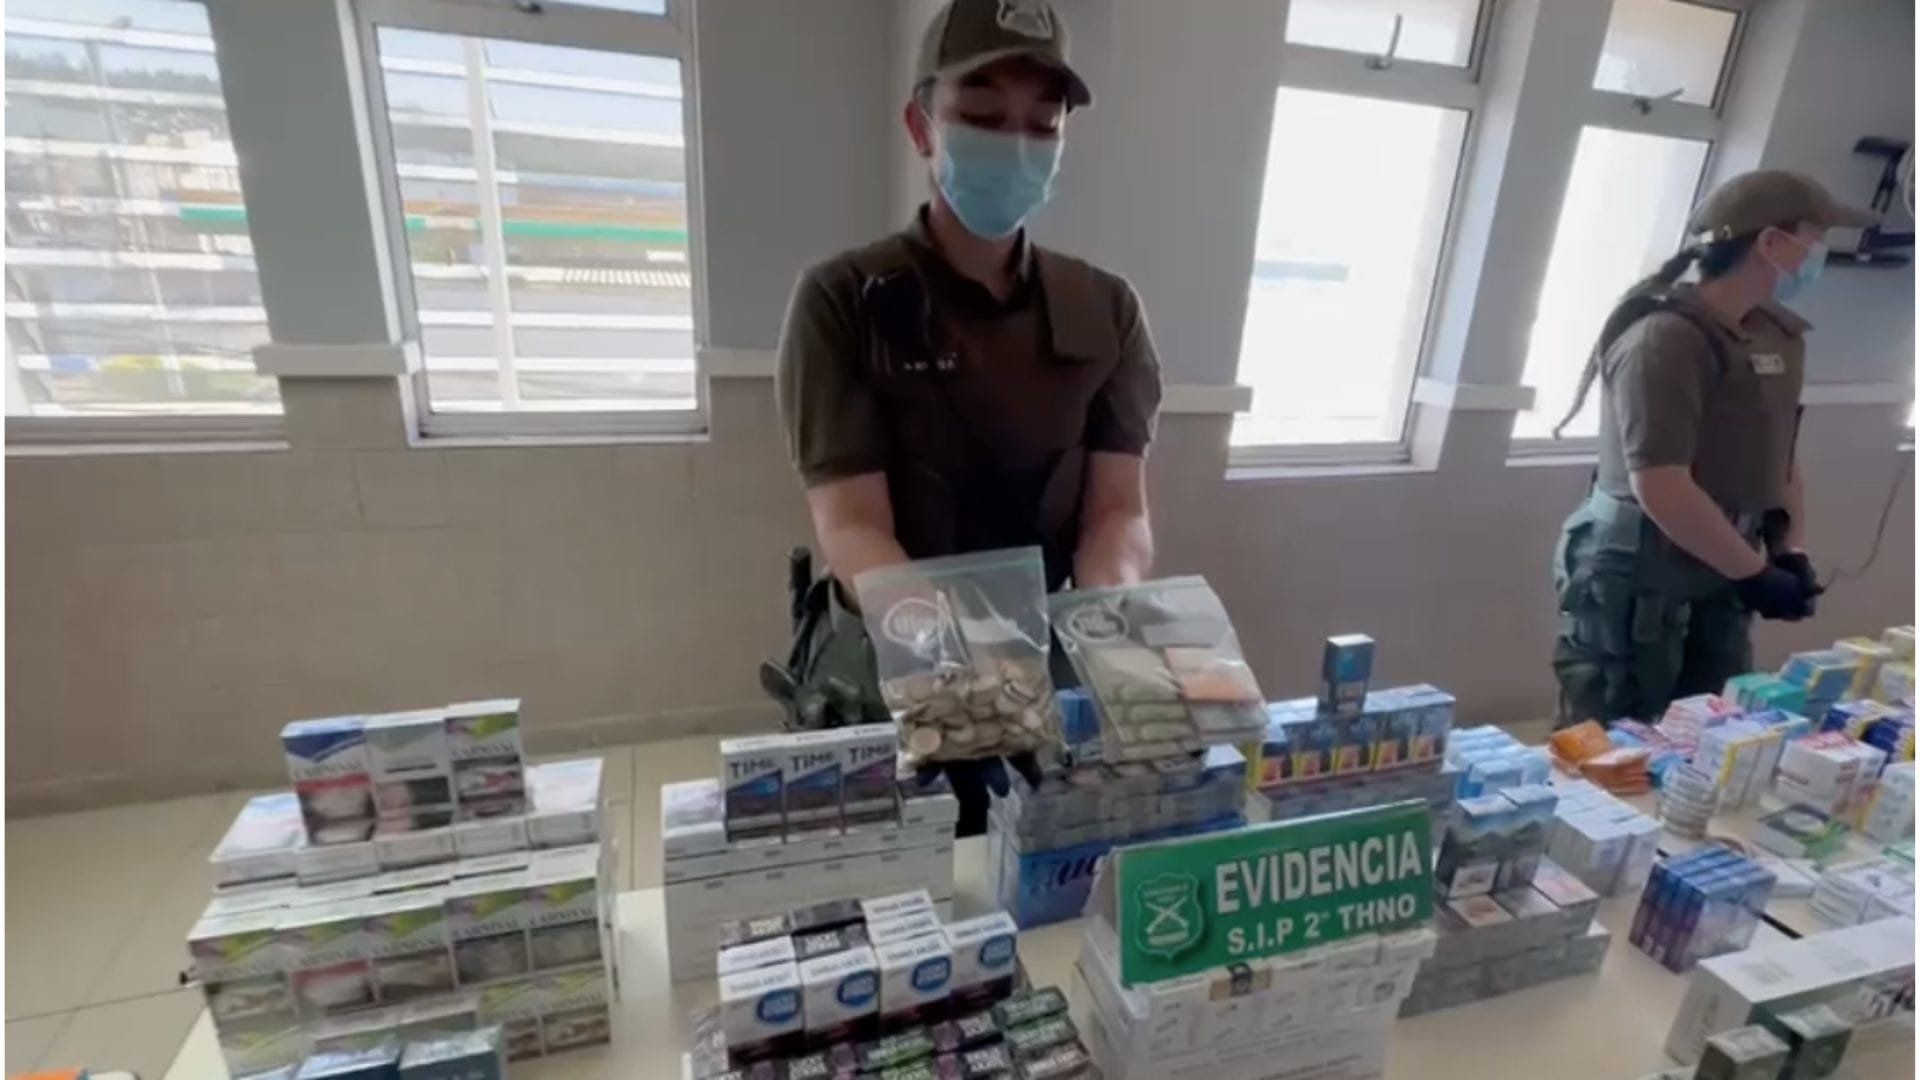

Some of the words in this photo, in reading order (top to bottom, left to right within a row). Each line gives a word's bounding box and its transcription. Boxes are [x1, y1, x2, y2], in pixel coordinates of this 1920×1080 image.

[789, 752, 835, 773] TIME
[849, 743, 892, 764] TIME
[729, 757, 777, 780] TIME
[1215, 829, 1423, 915] EVIDENCIA
[1227, 917, 1294, 955] S.I.P
[1337, 893, 1417, 931] THNO
